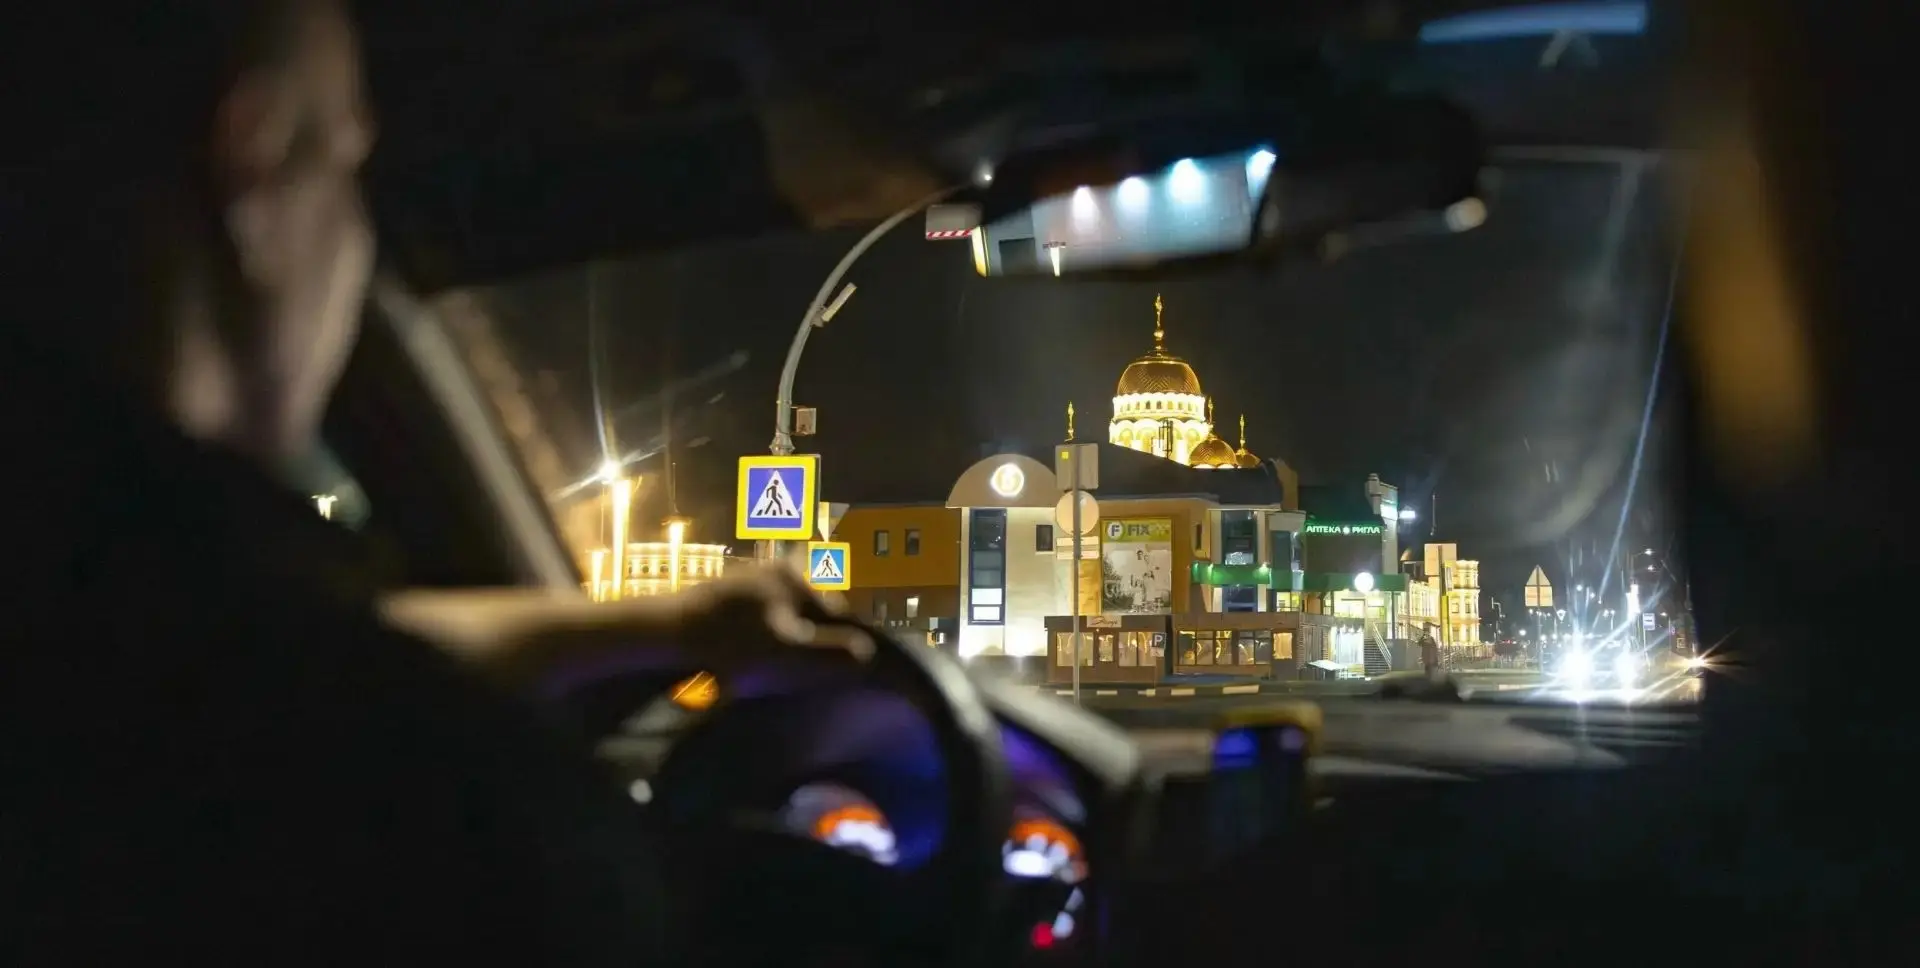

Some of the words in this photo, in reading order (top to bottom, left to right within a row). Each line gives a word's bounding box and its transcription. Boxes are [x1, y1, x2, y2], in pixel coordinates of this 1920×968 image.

[1306, 525, 1341, 533] АПТЕКА
[1351, 525, 1381, 534] РИГЛА
[1154, 635, 1163, 647] P
